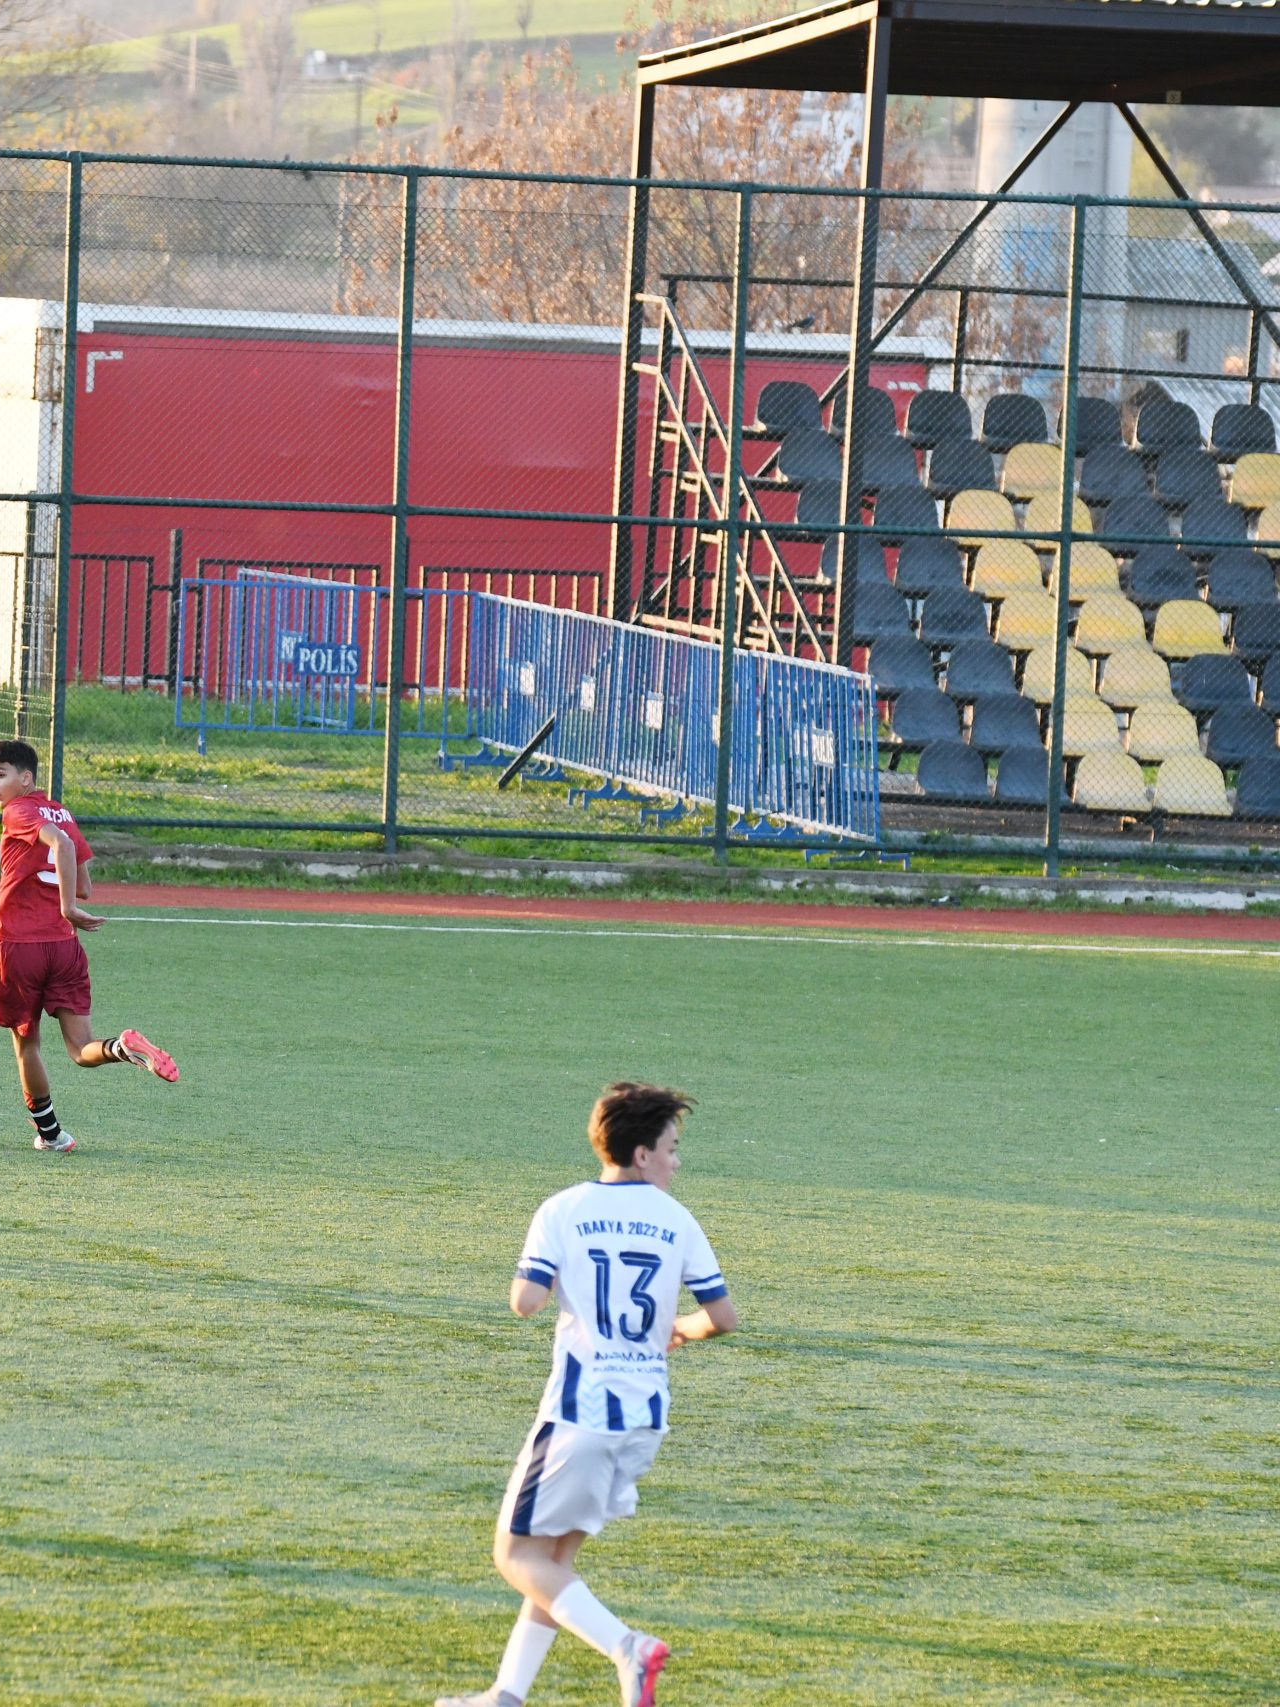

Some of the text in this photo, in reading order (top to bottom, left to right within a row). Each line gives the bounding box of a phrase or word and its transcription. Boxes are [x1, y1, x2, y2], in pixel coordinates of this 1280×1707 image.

[298, 644, 360, 675] POLİS
[576, 1219, 678, 1245] TRAKYA 2022 SK
[588, 1248, 663, 1344] 13
